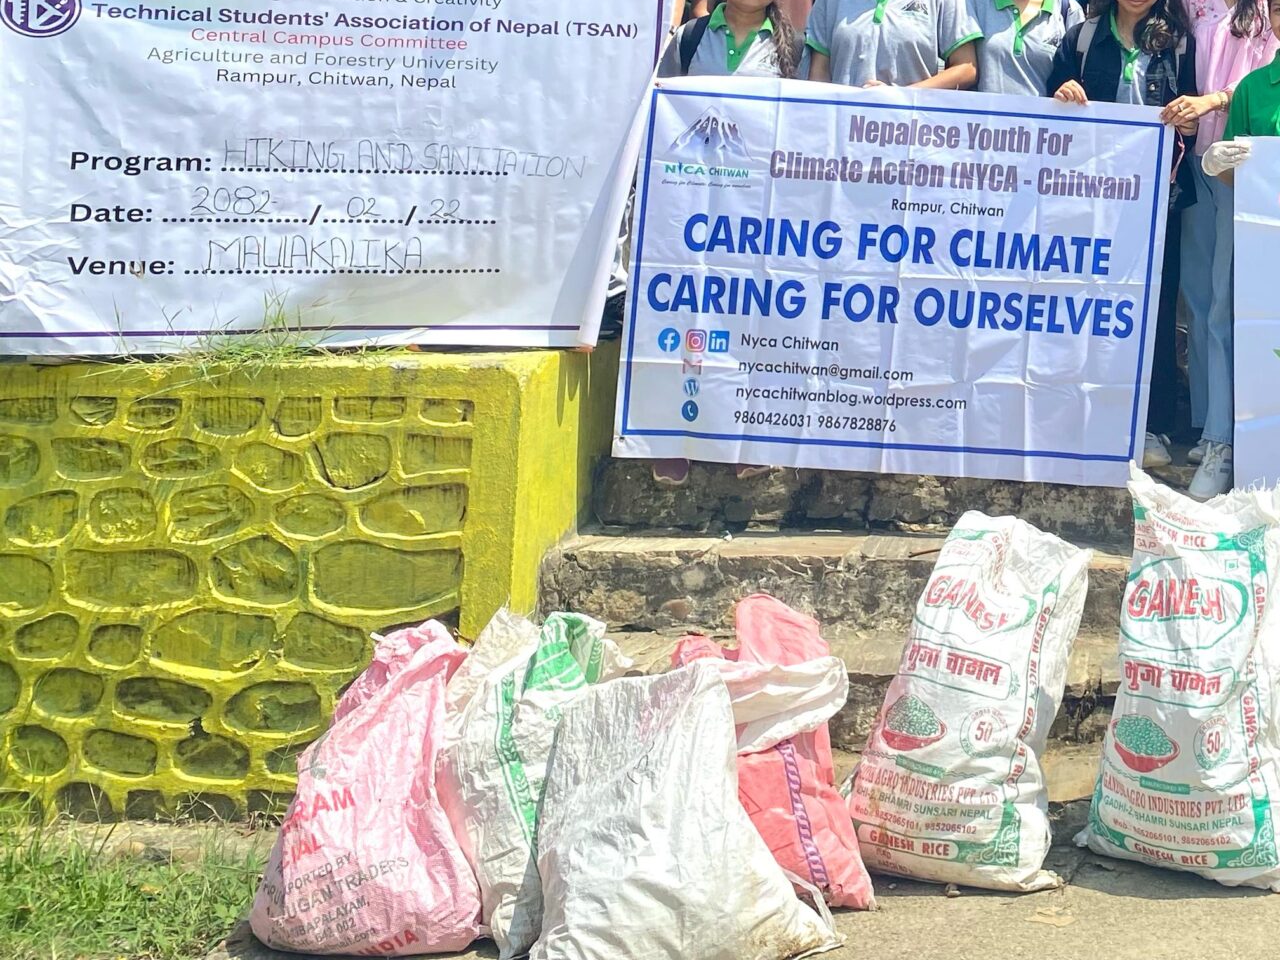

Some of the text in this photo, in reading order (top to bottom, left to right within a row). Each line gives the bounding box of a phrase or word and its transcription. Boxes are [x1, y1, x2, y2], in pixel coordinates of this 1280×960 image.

[91, 2, 638, 39] Technical Students' Association of Nepal (TSAN)
[191, 28, 468, 51] Central Campus Committee
[147, 47, 499, 74] Agriculture and Forestry University
[217, 69, 456, 91] Rampur, Chitwan, Nepal
[848, 114, 1073, 157] Nepalese Youth For
[70, 151, 211, 176] Program:
[224, 137, 345, 170] HIKING
[358, 139, 413, 170] AND
[709, 167, 749, 178] CHITWAN
[770, 149, 863, 184] Climate
[867, 156, 944, 189] Action
[950, 161, 1018, 193] (NYCA
[1037, 166, 1141, 202] Chitwan)
[70, 203, 153, 223] Date:
[891, 198, 1004, 218] Rampur, Chitwan
[684, 213, 1112, 276] CARING FOR CLIMATE
[68, 256, 175, 276] Venue:
[647, 273, 1135, 339] CARING FOR OURSELVES
[741, 333, 777, 350] Nyca
[782, 337, 839, 352] Chitwan
[738, 360, 914, 382] nycachitwan@gmail.com
[735, 386, 967, 409] nycachitwanblog.wordpress.com
[733, 411, 896, 432] 9860426031 9867828876
[975, 721, 993, 743] 50
[1207, 731, 1221, 755] 50
[913, 803, 957, 818] SUNSARI
[959, 809, 993, 820] NEPAL
[1149, 794, 1201, 818] INDUSTRIES
[1169, 819, 1210, 832] SUNSARI
[1212, 816, 1244, 831] NEPAL
[869, 830, 950, 857] GANESH RICE
[1134, 843, 1208, 866] GANESH RICE
